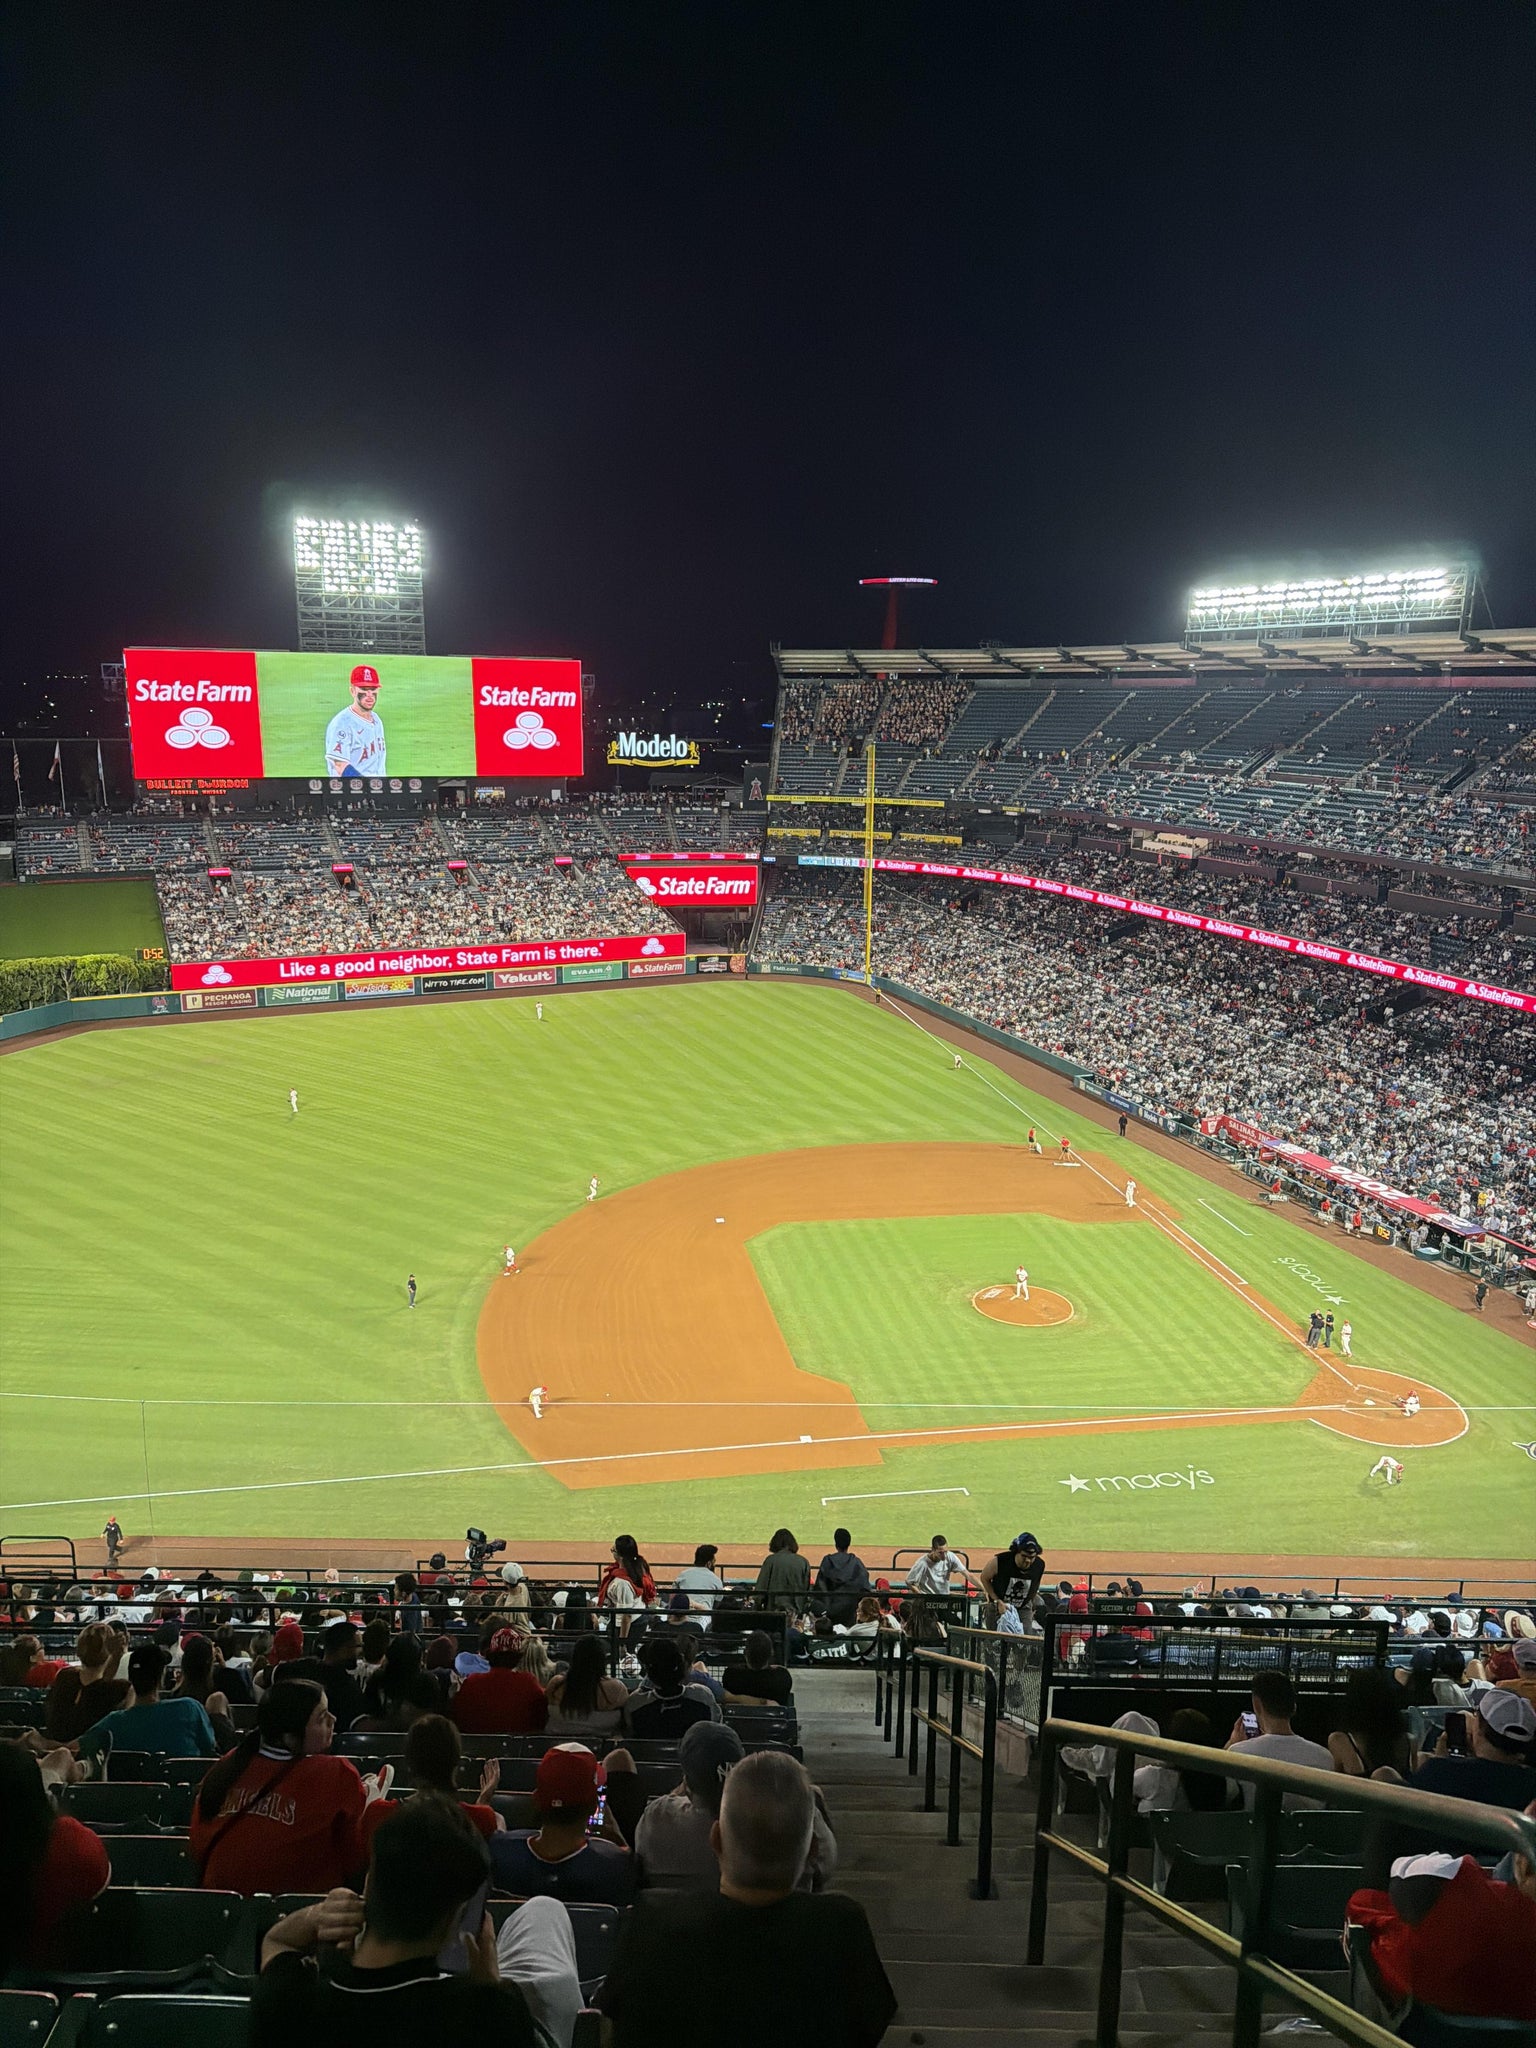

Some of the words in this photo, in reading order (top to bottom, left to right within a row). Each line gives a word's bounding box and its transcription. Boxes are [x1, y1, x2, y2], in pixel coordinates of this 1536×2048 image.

[619, 732, 688, 758] Modelo
[146, 780, 192, 789] BULLEIT
[143, 948, 164, 960] 0:52
[279, 961, 316, 978] Like
[320, 963, 330, 975] a
[335, 957, 376, 978] good
[380, 952, 453, 973] neighbor,
[456, 949, 498, 966] State
[502, 947, 540, 964] Farm
[544, 946, 556, 961] is
[560, 944, 602, 960] there.
[424, 980, 448, 988] NITTO
[450, 977, 484, 986] TIRE.COM
[498, 972, 552, 984] Yakult
[286, 984, 331, 998] National
[350, 982, 389, 994] Surfside
[204, 992, 252, 1002] PECHANGA
[1228, 1120, 1256, 1140] SALINAS,
[1100, 1604, 1124, 1612] SECTION
